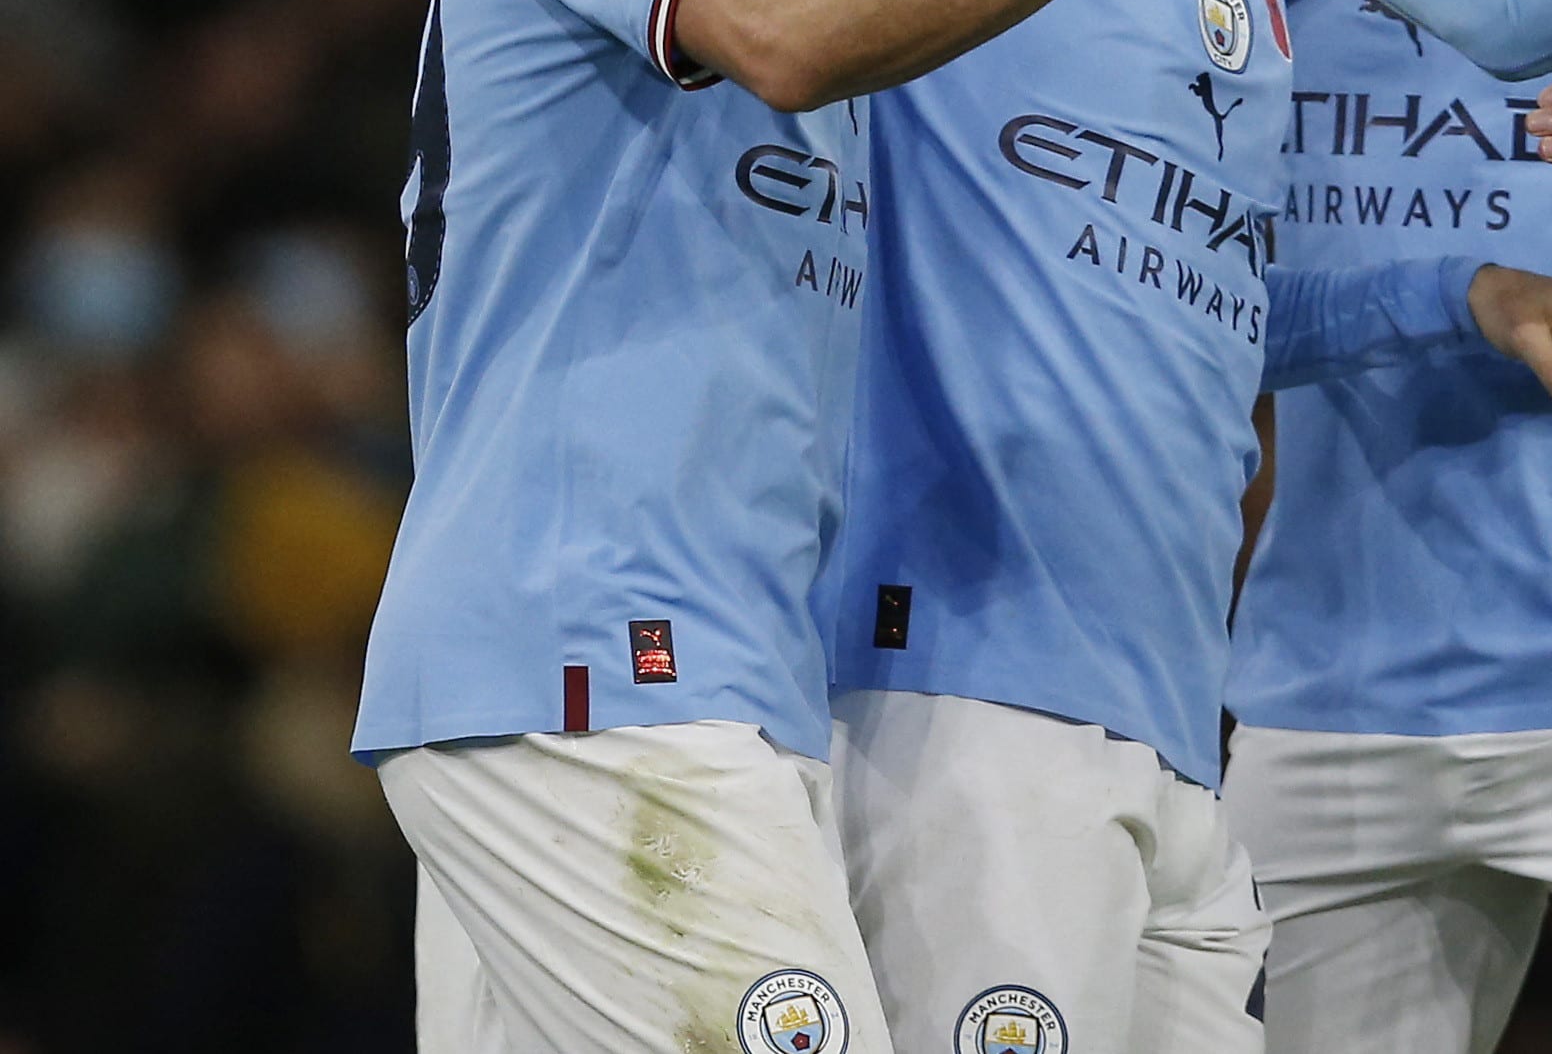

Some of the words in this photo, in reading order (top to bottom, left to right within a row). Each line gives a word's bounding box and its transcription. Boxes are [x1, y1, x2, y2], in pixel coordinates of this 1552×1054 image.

[1284, 184, 1511, 230] AIRWAYS
[1066, 224, 1261, 344] AIRWAYS
[747, 978, 830, 1021] MANCHESTER
[968, 994, 1056, 1030] MANCHESTER
